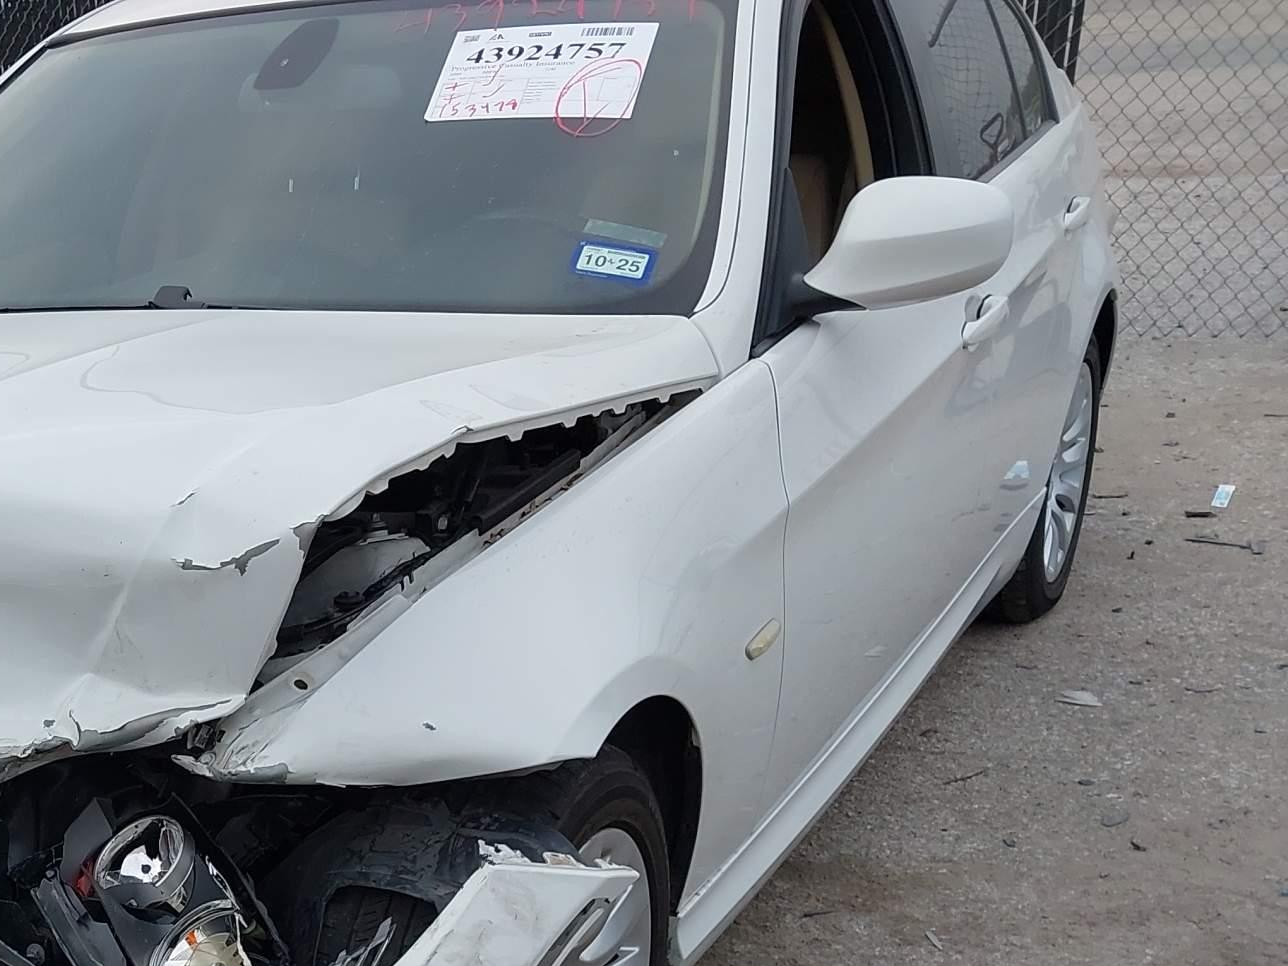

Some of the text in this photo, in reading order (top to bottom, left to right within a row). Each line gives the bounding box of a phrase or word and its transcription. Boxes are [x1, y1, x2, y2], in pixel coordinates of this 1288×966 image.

[466, 42, 627, 63] 43924757
[584, 253, 642, 273] 10 25
